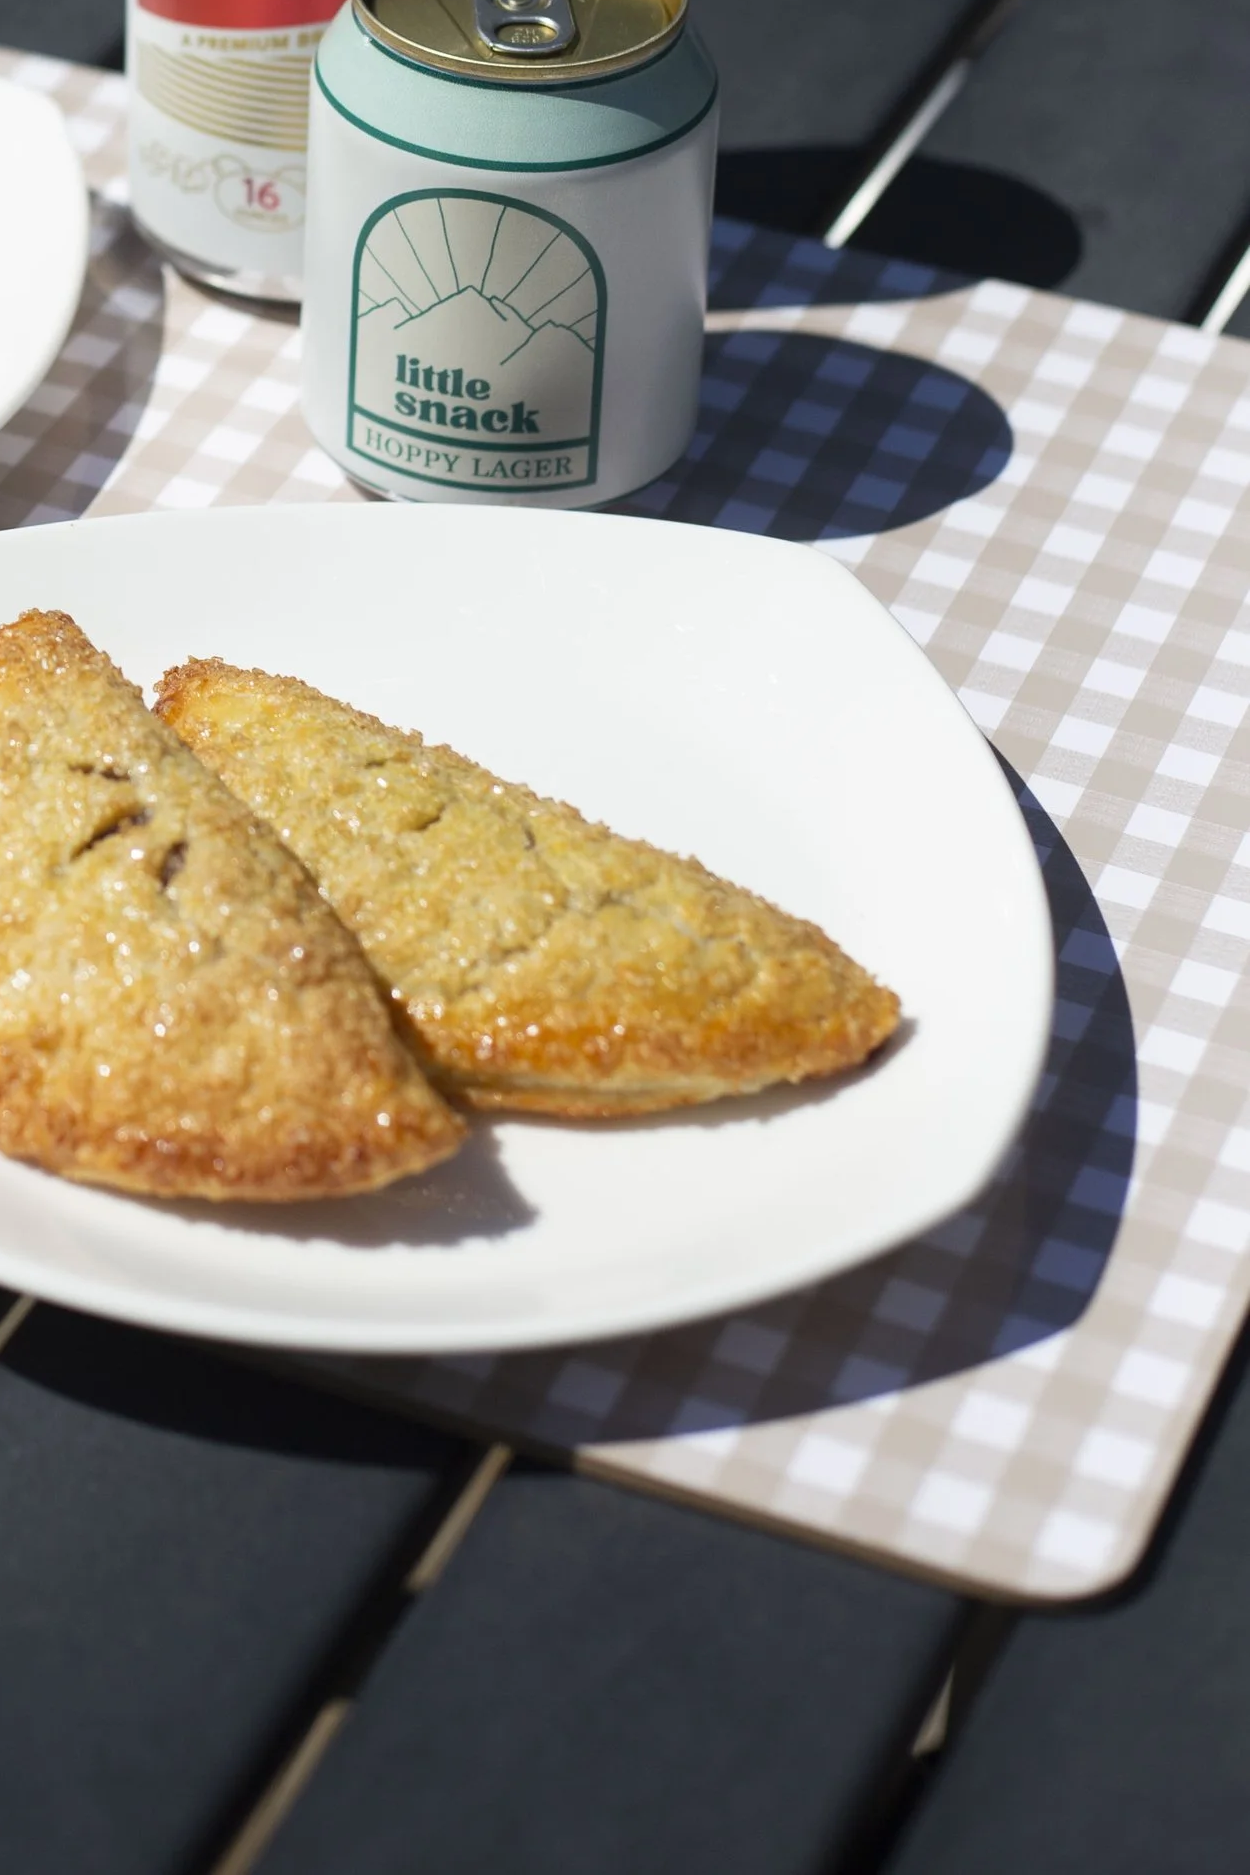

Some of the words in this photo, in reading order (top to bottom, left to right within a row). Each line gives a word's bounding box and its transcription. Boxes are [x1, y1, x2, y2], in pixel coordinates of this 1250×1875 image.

[196, 33, 289, 51] PREMIUM
[243, 177, 281, 213] 16
[395, 354, 491, 401] little
[394, 391, 540, 434] snack
[365, 427, 461, 473] HOPPY
[473, 456, 573, 479] LAGER
